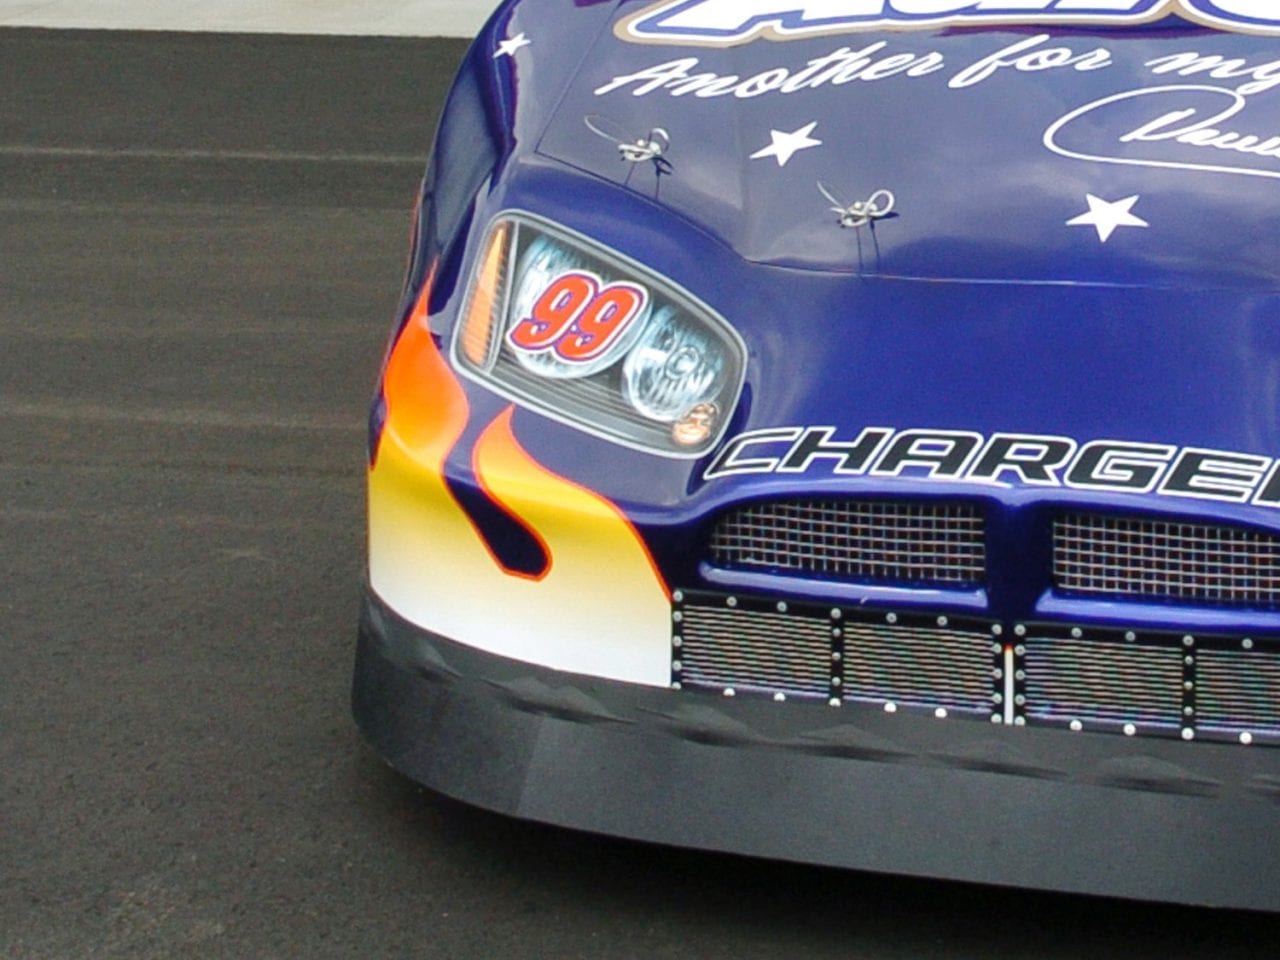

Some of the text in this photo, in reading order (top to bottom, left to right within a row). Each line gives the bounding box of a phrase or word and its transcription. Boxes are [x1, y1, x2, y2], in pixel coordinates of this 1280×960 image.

[594, 40, 945, 98] Another
[947, 34, 1112, 89] for
[506, 269, 649, 365] 99
